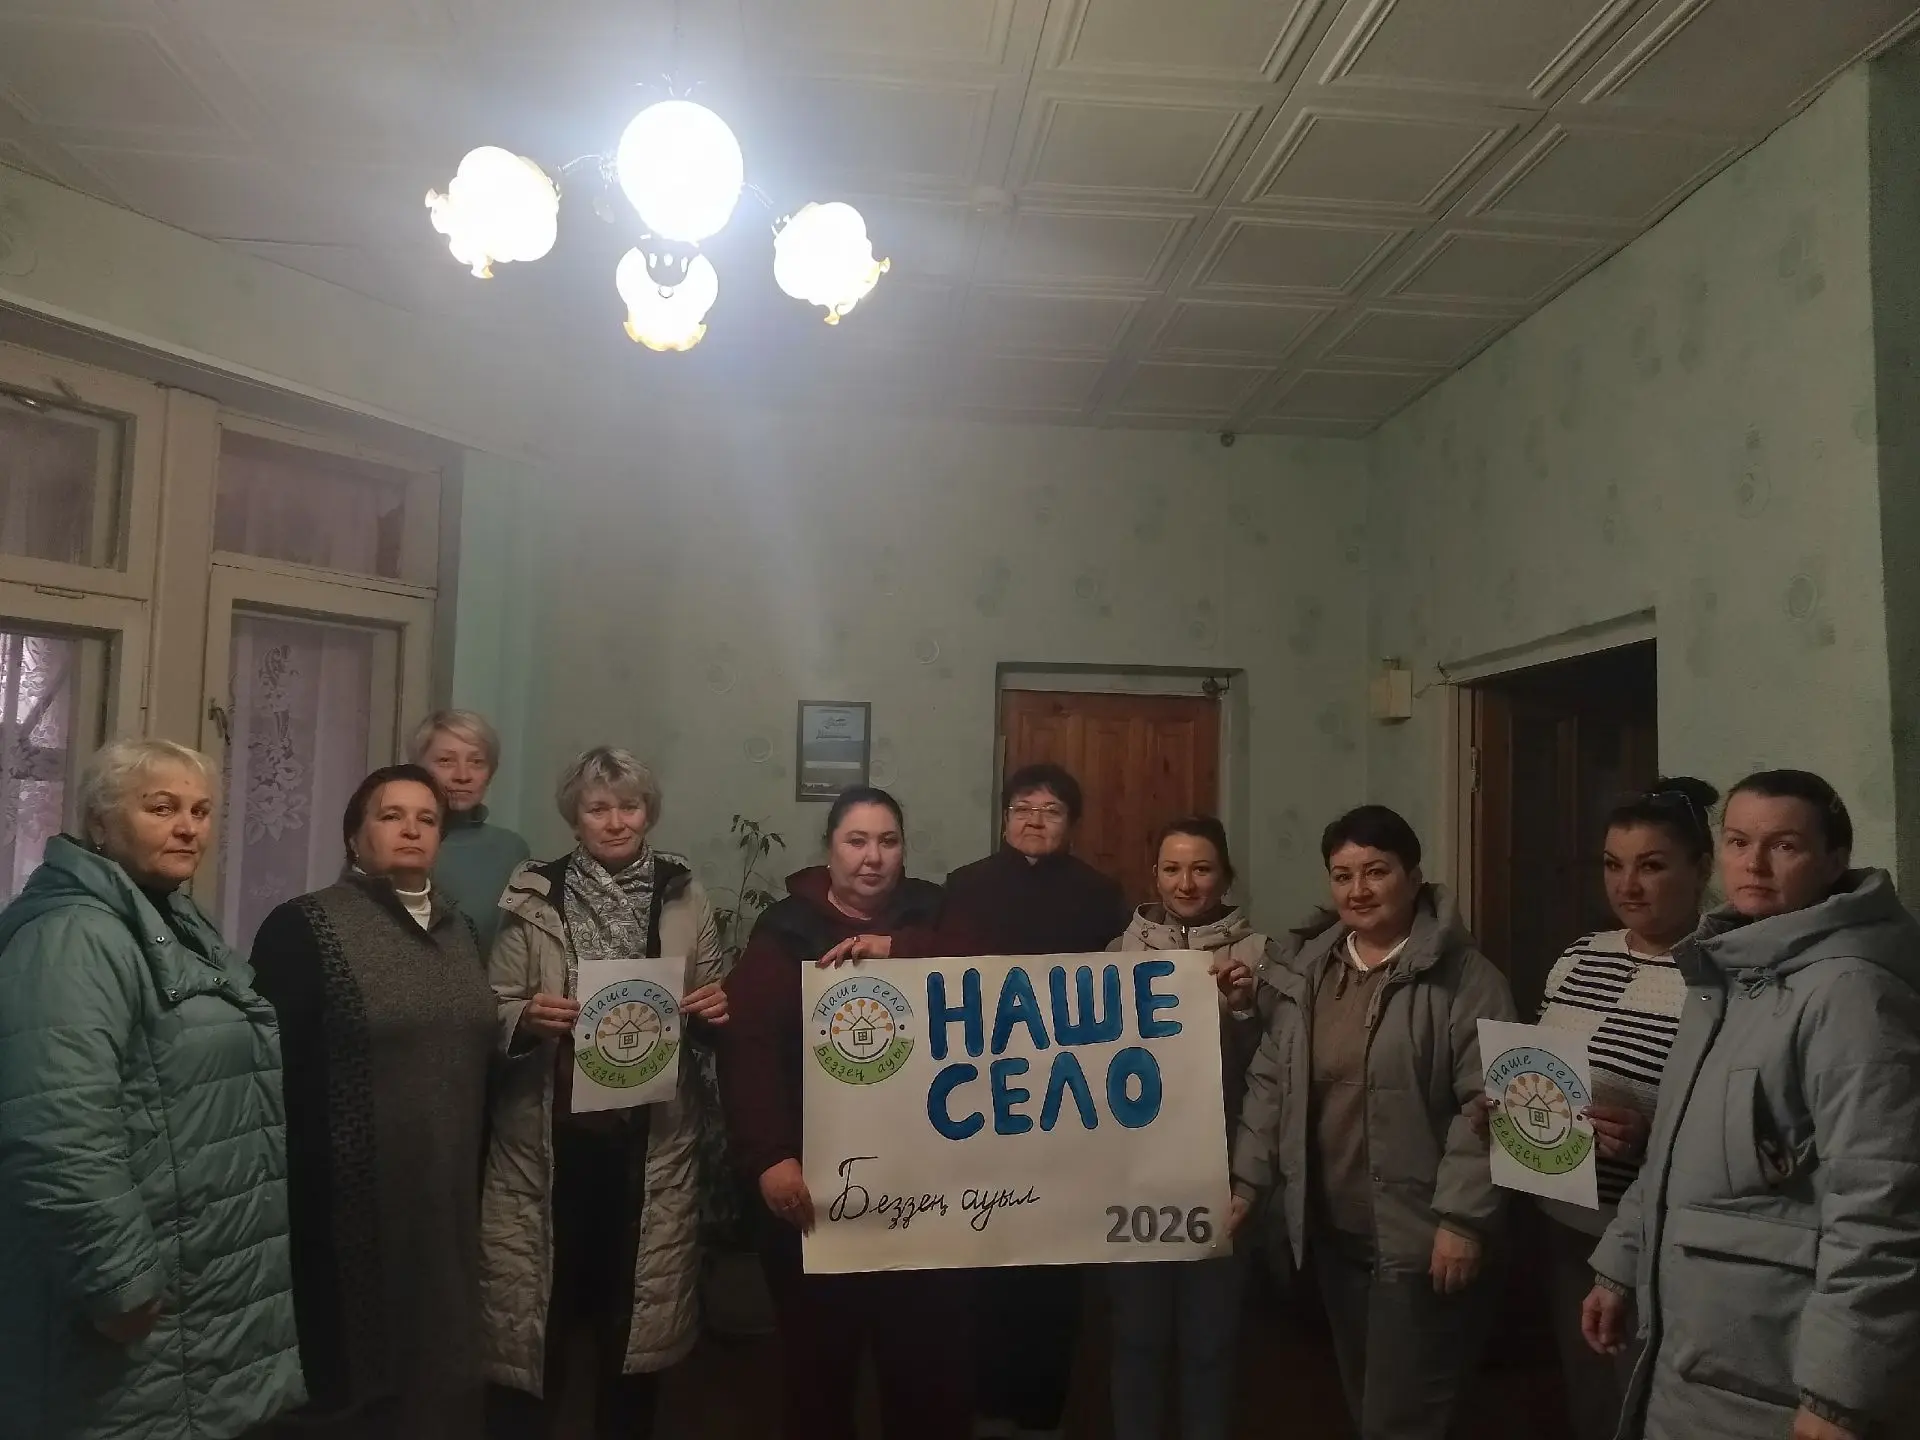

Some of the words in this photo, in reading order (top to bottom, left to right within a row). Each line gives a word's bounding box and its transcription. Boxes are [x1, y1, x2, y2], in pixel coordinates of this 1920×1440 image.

[584, 987, 630, 1021] Наше
[643, 987, 673, 1015] село
[818, 984, 858, 1016] Наше
[872, 984, 905, 1012] село
[926, 960, 1183, 1060] НАШЕ
[640, 1041, 673, 1076] ауыл
[878, 1041, 909, 1074] ауыл
[927, 1047, 1162, 1141] СЕЛО
[1491, 1054, 1532, 1086] Наше
[1546, 1062, 1582, 1100] село
[1555, 1135, 1589, 1166] ауыл
[961, 1186, 1041, 1232] ауыл
[1105, 1205, 1213, 1245] 2026
